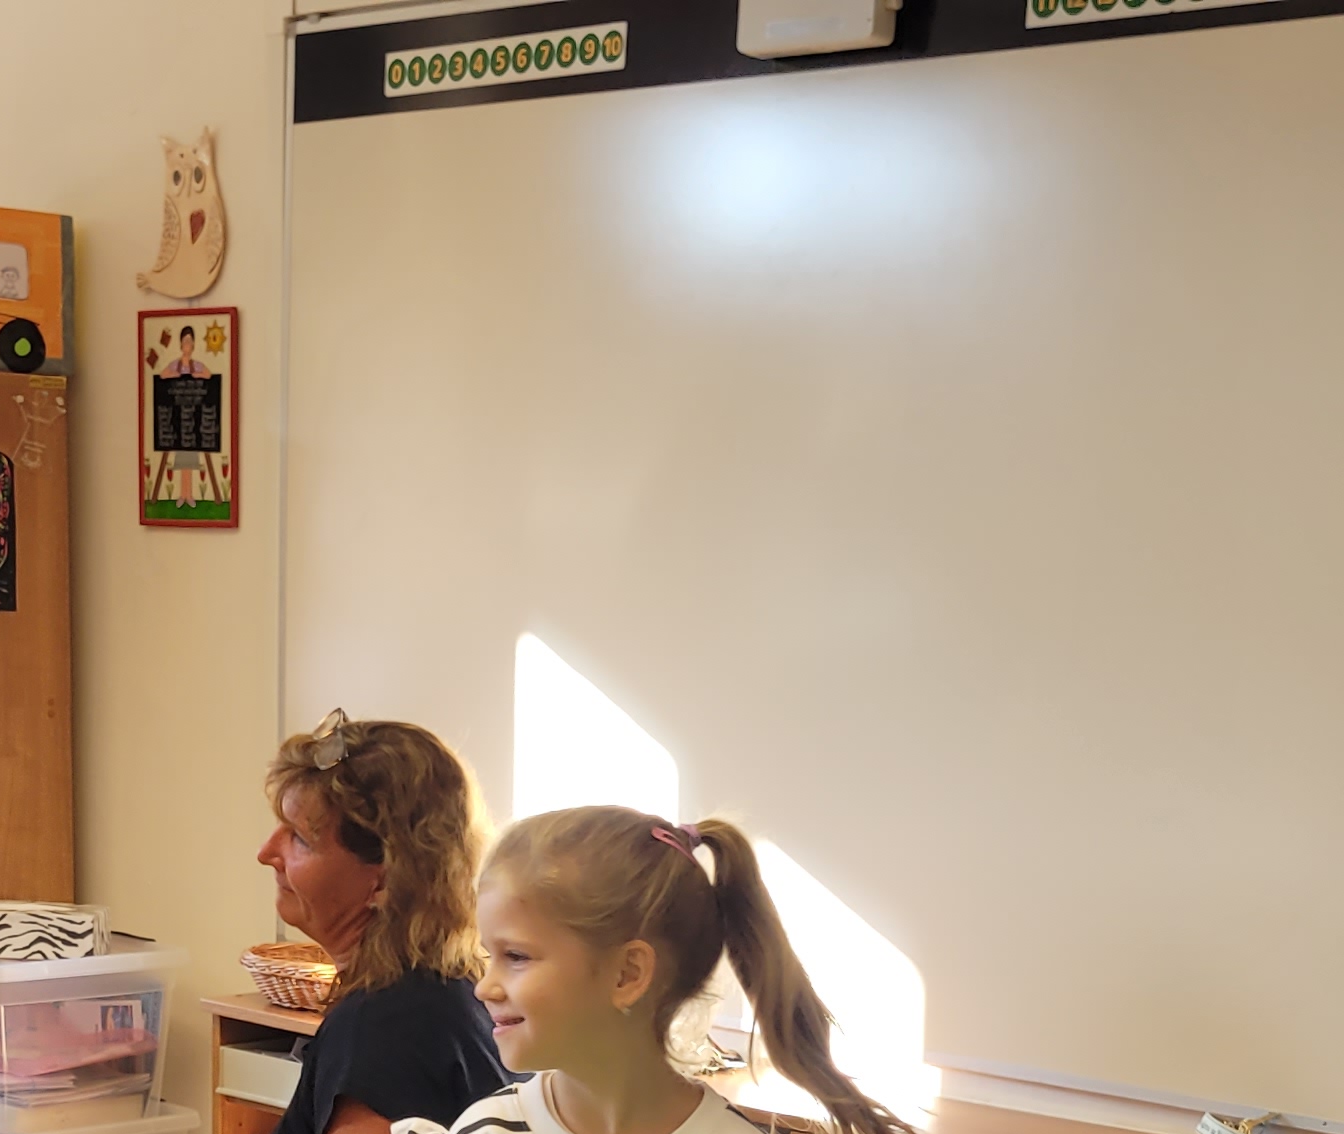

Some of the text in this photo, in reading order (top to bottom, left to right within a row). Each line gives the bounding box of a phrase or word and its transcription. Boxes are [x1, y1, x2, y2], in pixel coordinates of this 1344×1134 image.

[391, 35, 623, 84] 0 1 2 3 4 5 6 7 8 9 10
